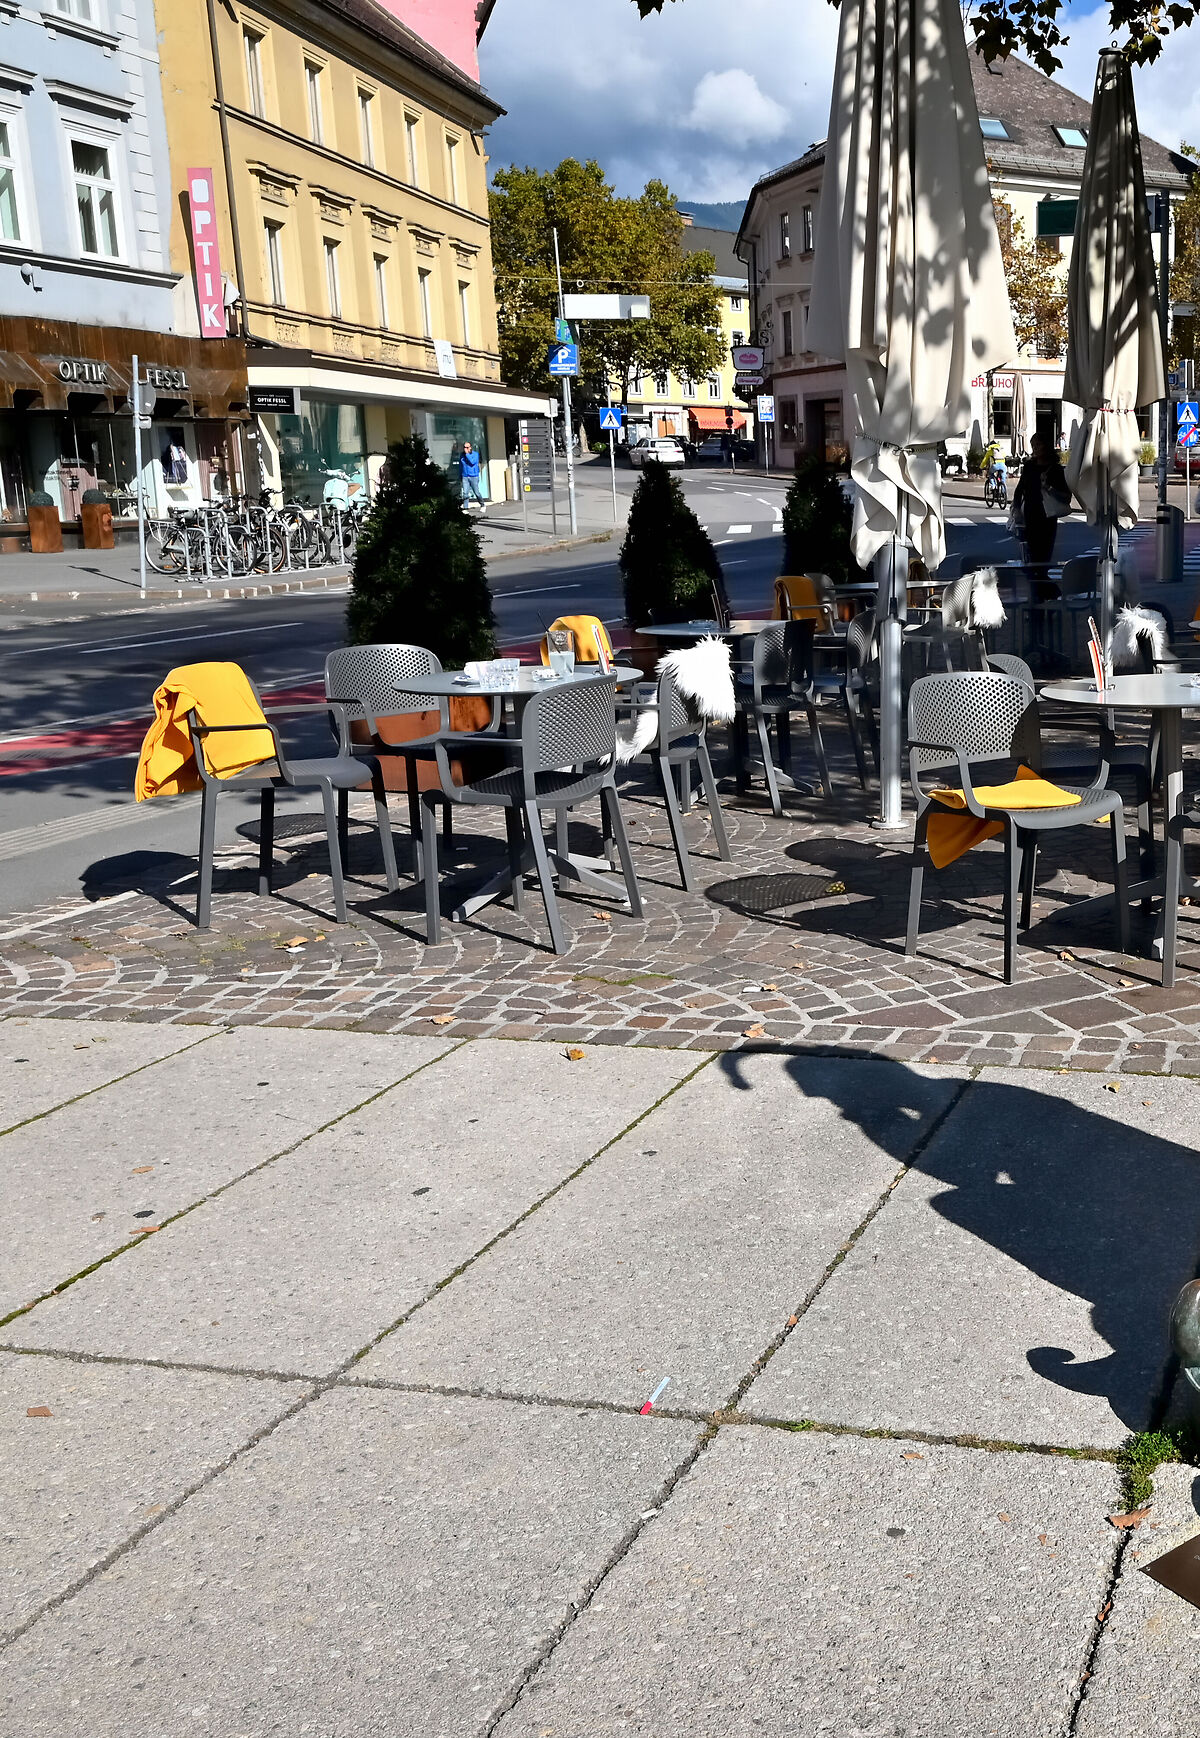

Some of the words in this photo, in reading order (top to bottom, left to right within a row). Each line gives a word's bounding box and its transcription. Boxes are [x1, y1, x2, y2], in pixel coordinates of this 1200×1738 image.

[191, 178, 221, 327] OPTIK
[59, 360, 109, 383] OPTIK
[146, 368, 190, 391] FESSL
